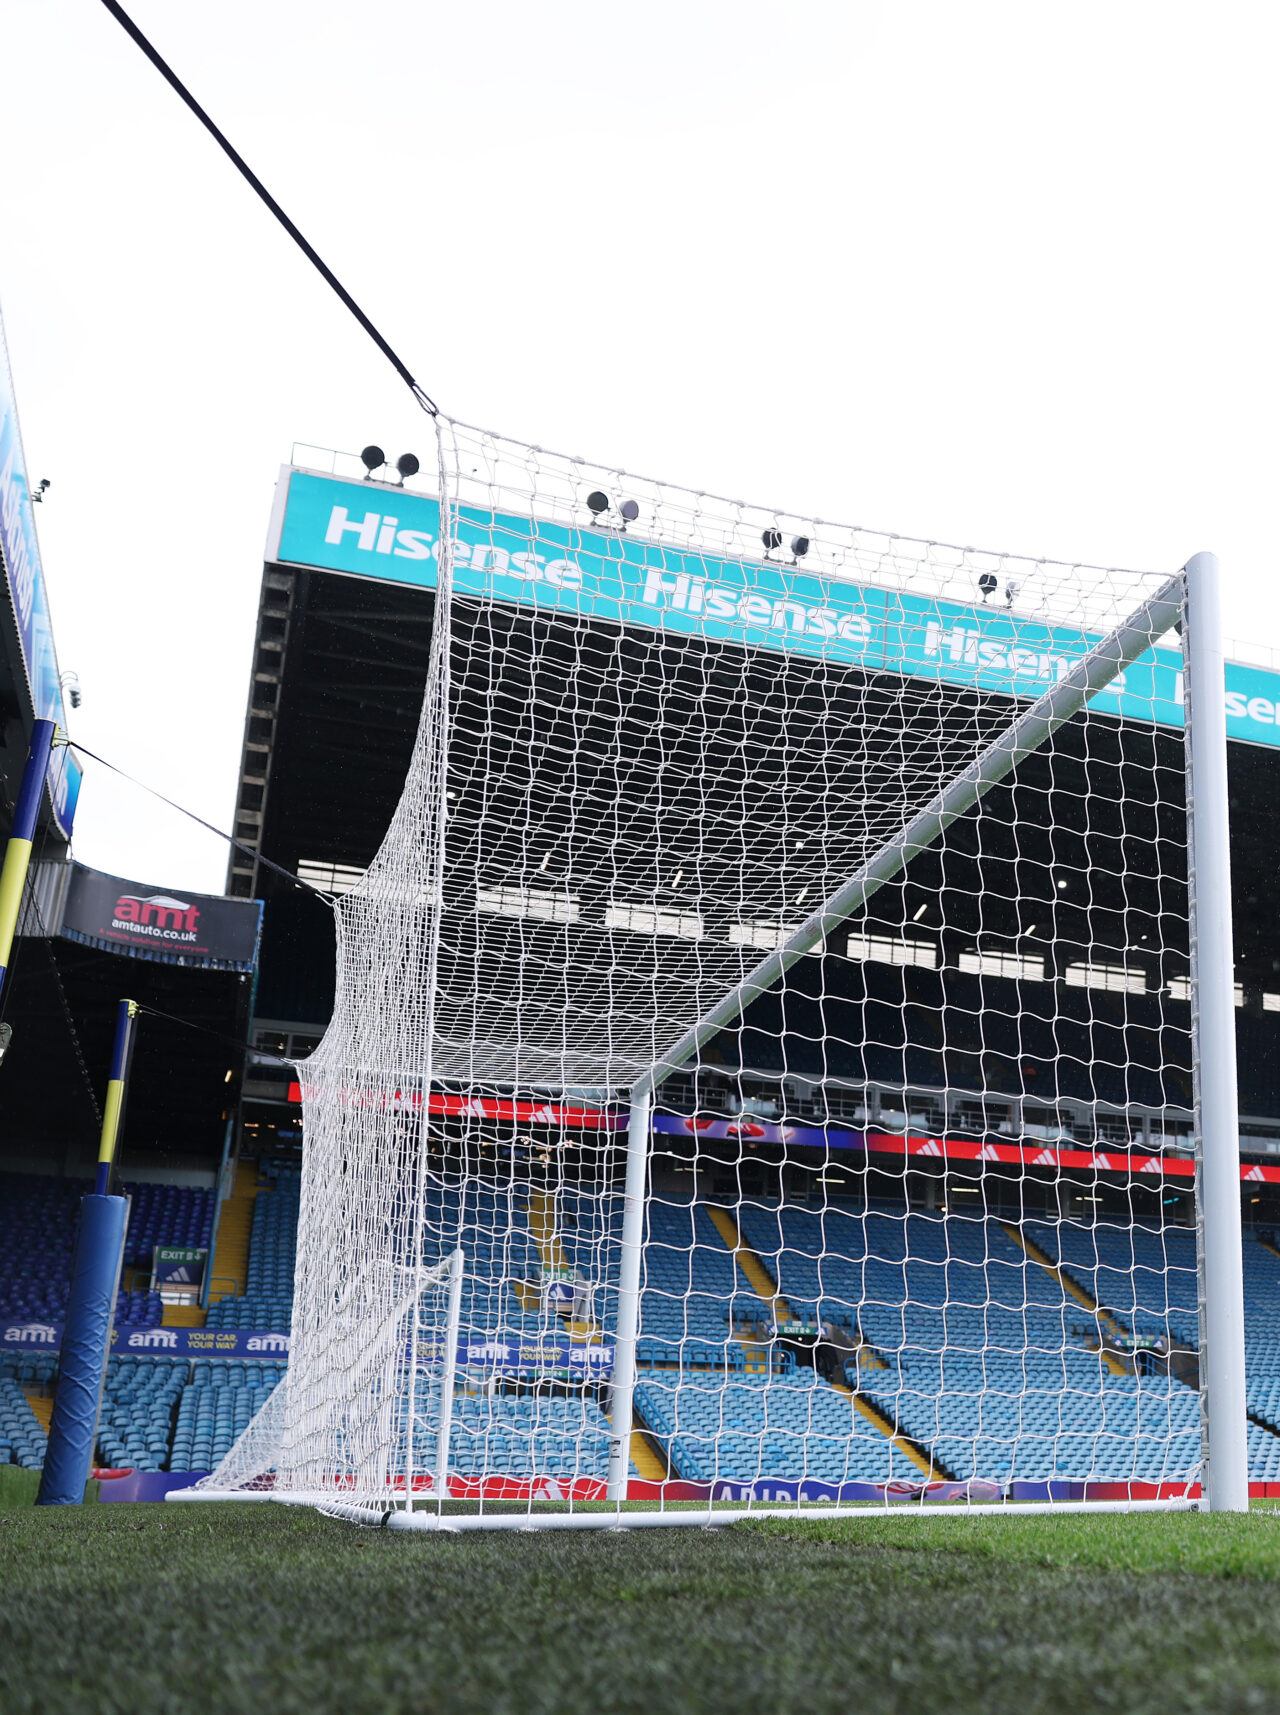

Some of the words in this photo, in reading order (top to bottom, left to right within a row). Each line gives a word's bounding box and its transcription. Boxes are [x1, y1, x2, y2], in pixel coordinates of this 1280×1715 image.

[323, 505, 582, 590] Hisense
[641, 567, 872, 643] Hisense
[923, 621, 1127, 692] Hisen
[114, 898, 200, 932] amt
[112, 919, 197, 942] amtauto.co.uk
[160, 1250, 185, 1260] EXIT
[4, 1325, 57, 1343] amt
[128, 1331, 178, 1348] amt
[188, 1333, 214, 1341] YOUR
[187, 1341, 214, 1349] YOUR
[215, 1342, 237, 1350] WAY
[571, 1347, 612, 1363] amt
